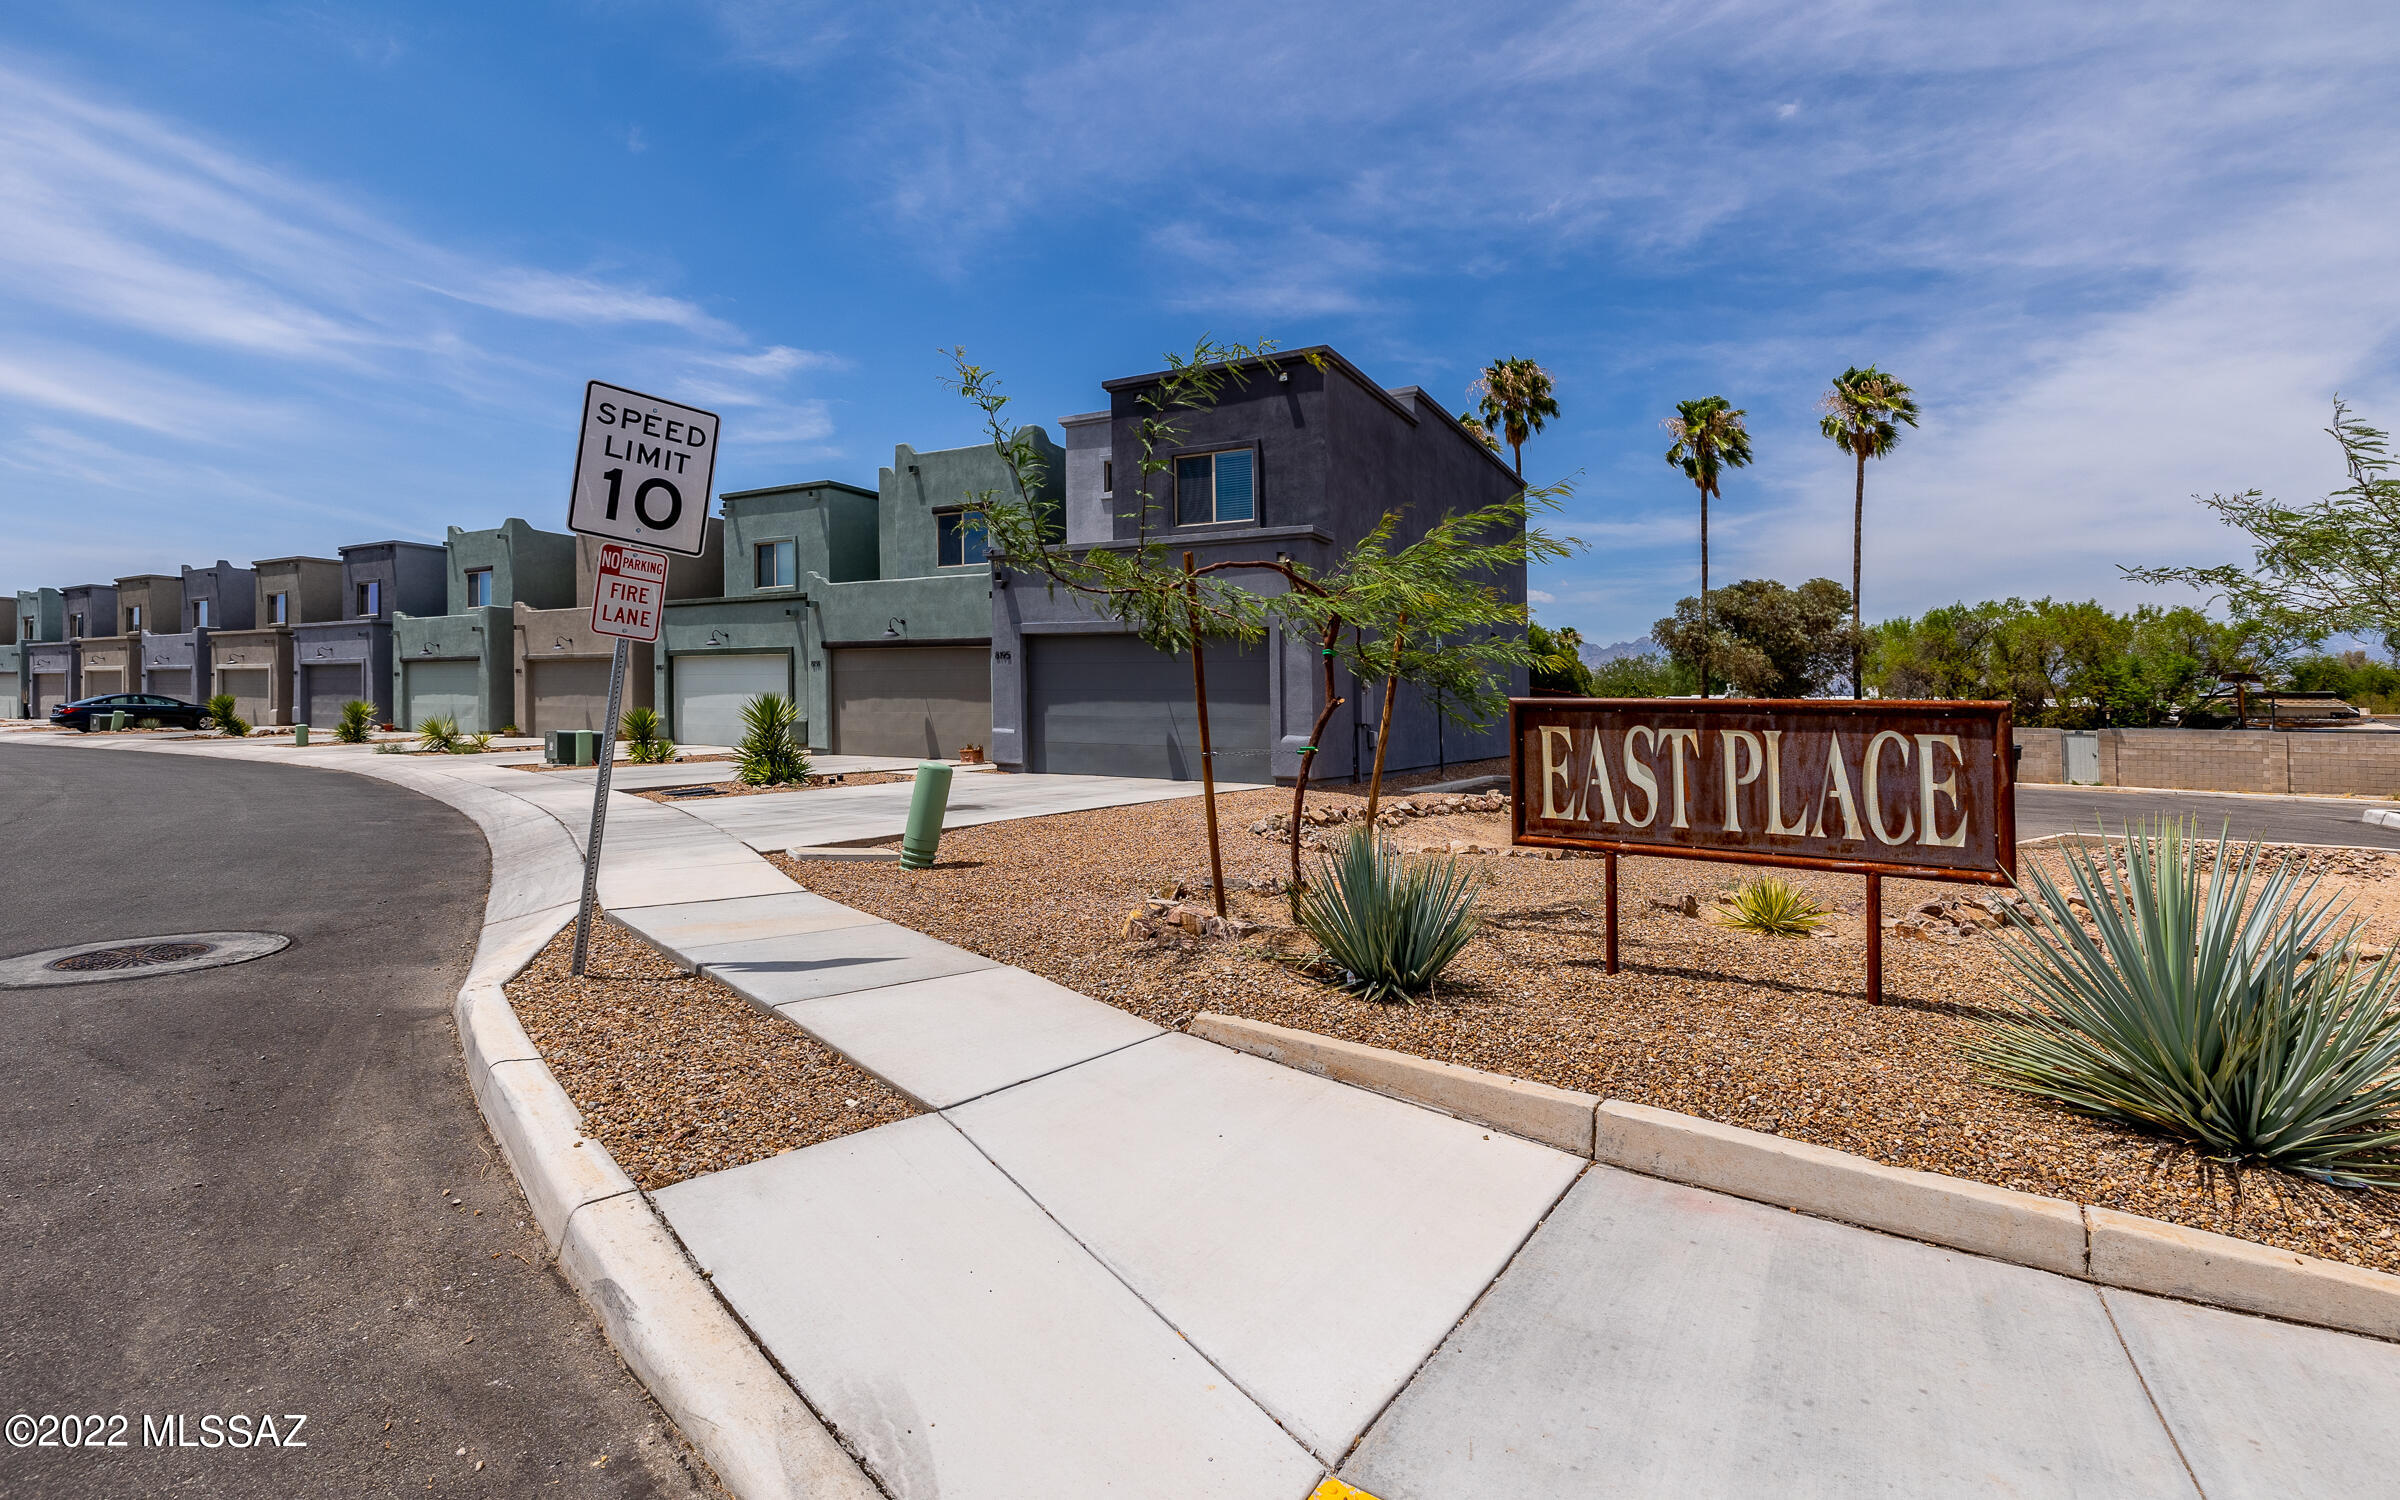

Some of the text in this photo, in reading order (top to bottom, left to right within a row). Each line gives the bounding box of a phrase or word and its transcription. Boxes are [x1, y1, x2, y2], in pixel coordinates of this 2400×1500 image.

[596, 402, 706, 448] SPEED
[604, 435, 691, 474] LIMIT
[603, 467, 682, 530] 10
[601, 550, 663, 575] NO PARKING
[610, 582, 649, 604] FIRE
[602, 605, 651, 627] LANE
[1538, 725, 1969, 849] EAST PLACE
